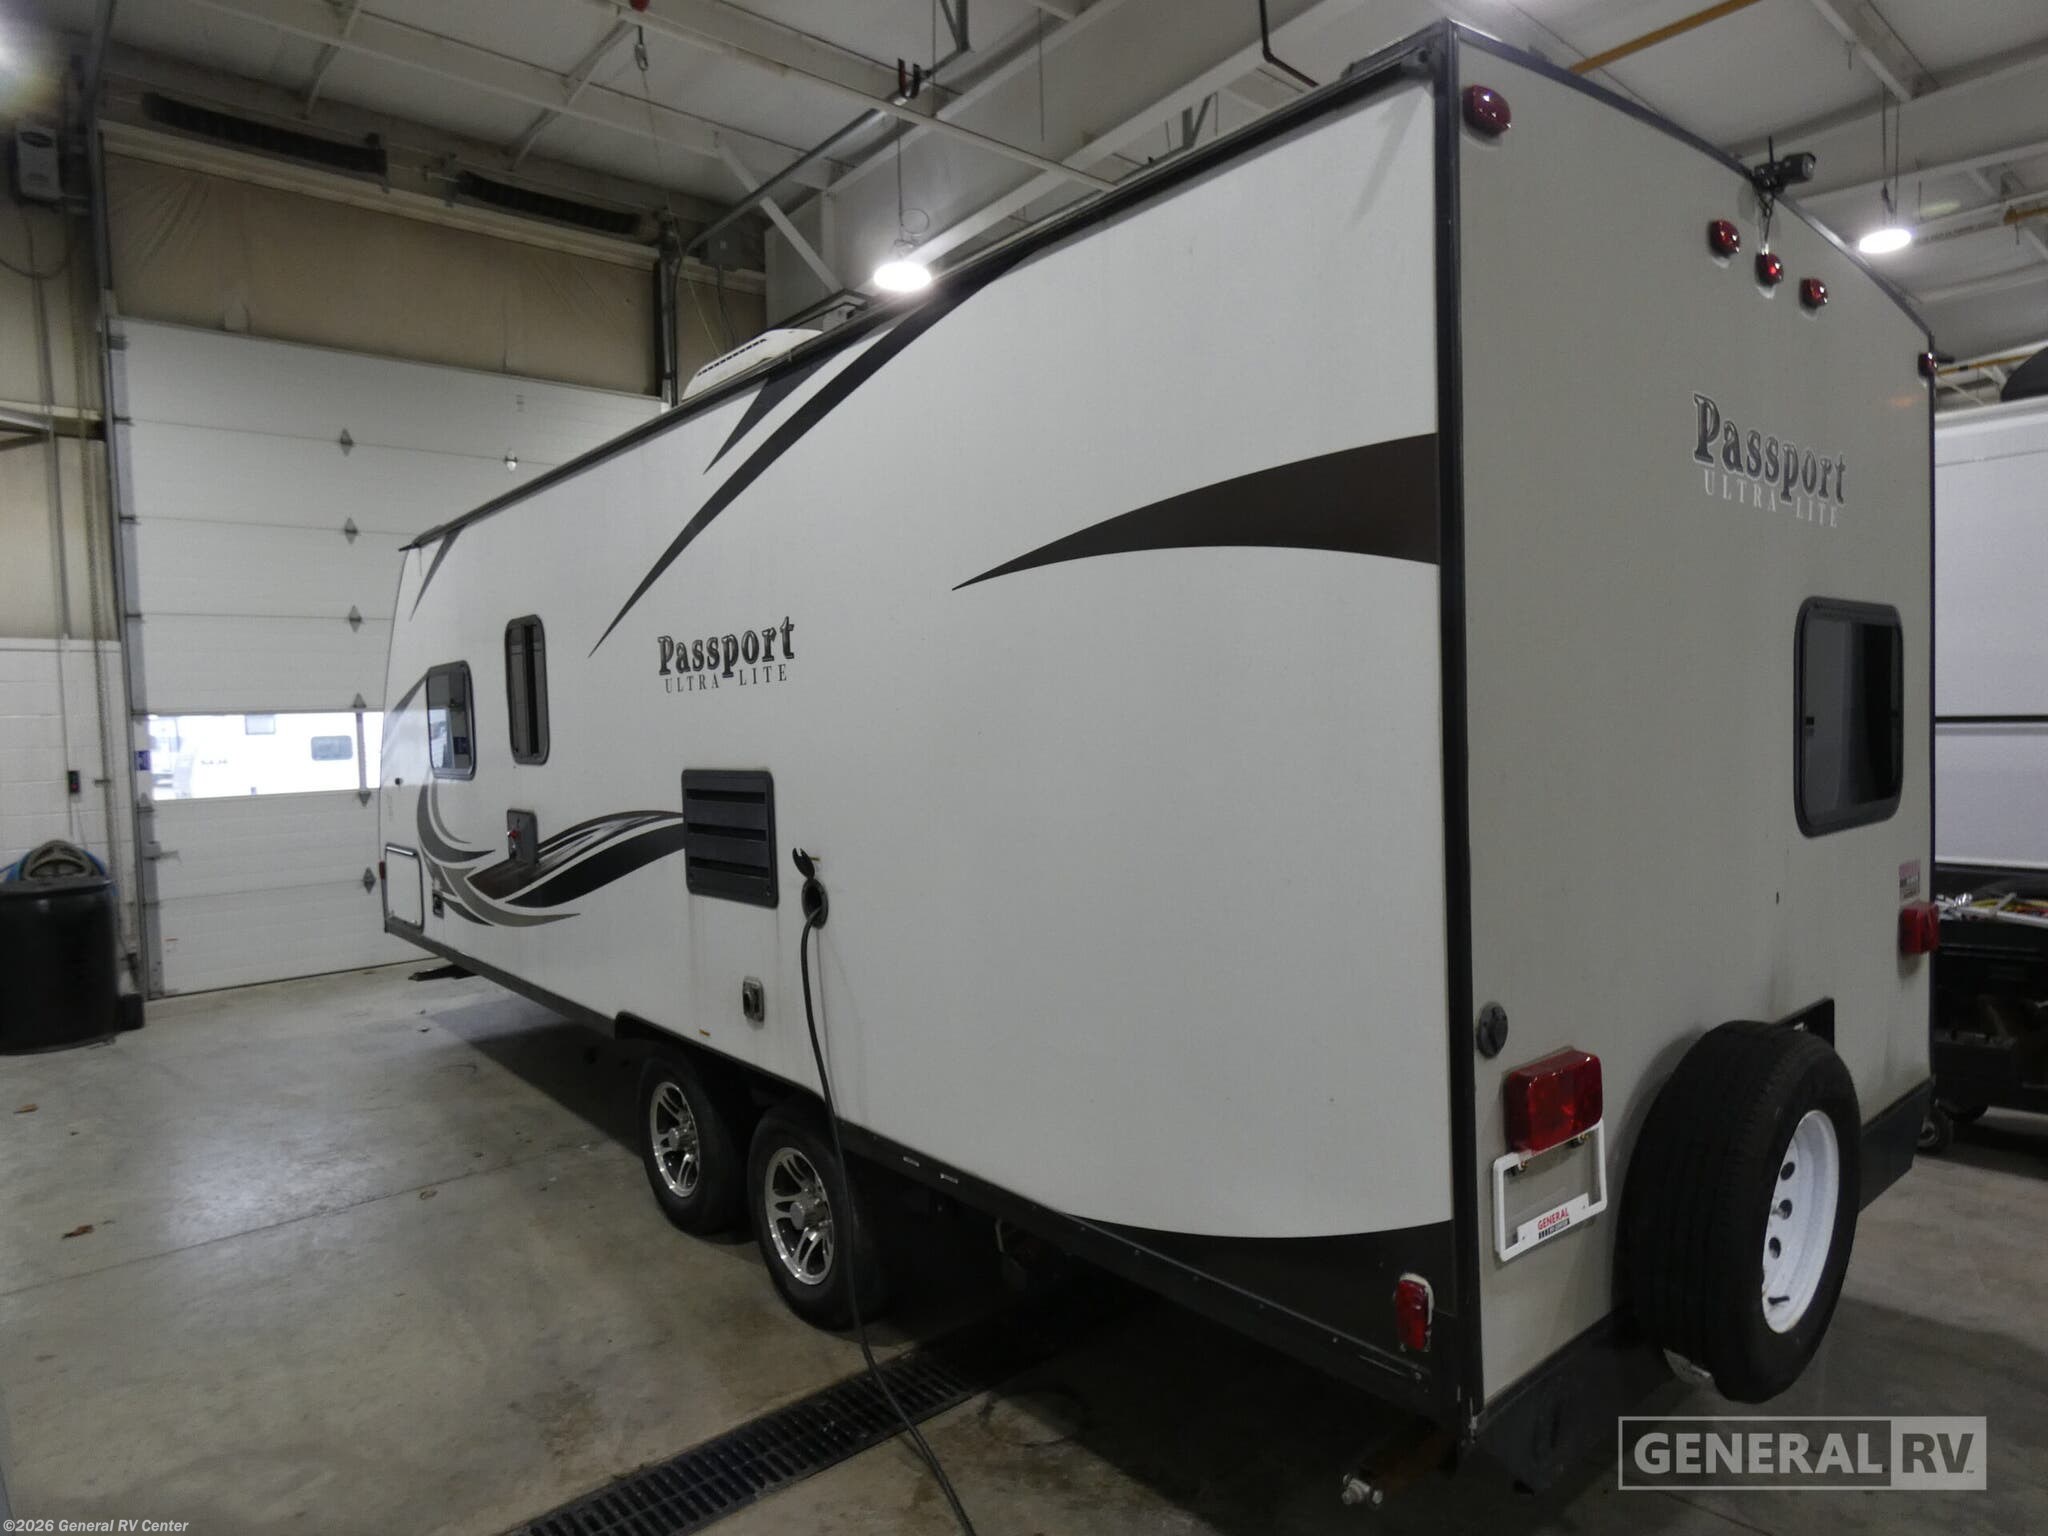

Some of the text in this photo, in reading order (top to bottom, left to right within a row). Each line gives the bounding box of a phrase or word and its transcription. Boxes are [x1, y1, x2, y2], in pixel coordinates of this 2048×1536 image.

[1693, 391, 1848, 504] Passport
[1703, 469, 1838, 528] ULTRA LITE
[657, 616, 795, 678] Passport
[665, 664, 788, 694] ULTRA LITE
[1537, 1207, 1569, 1230] GENERAL
